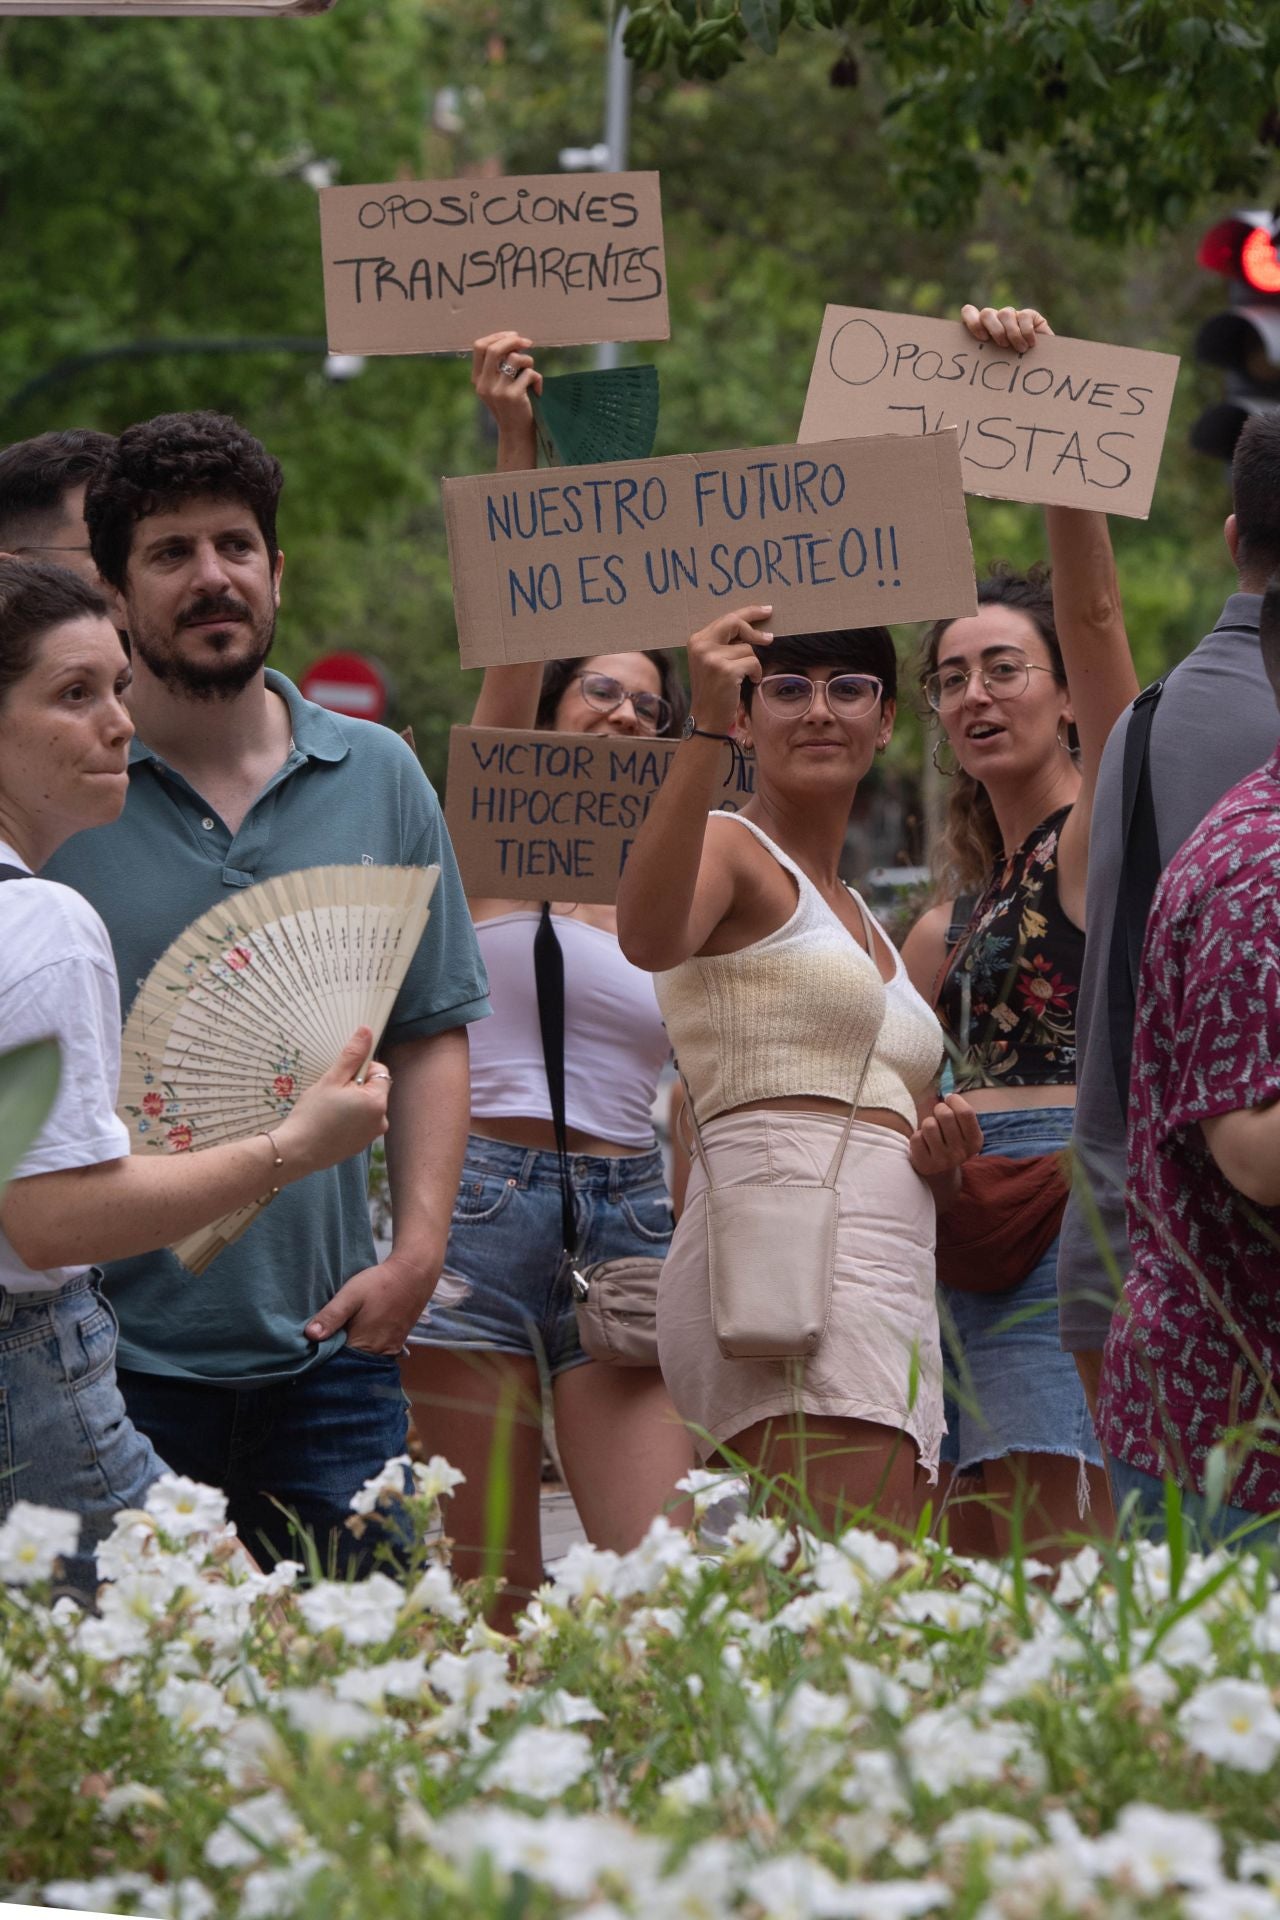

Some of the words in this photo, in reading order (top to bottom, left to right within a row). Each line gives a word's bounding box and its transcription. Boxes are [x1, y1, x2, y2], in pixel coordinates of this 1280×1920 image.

[333, 243, 662, 303] TRANSPARENTES
[829, 318, 1153, 415] OPOSICIONES
[487, 476, 668, 542] NUESTRO
[693, 460, 846, 527] FUTURO
[508, 563, 562, 617] NO
[578, 554, 627, 605] ES
[645, 546, 698, 595] UN
[708, 525, 901, 597] SORTEO!!
[471, 741, 594, 780] VICTOR
[495, 838, 595, 879] TIENE
